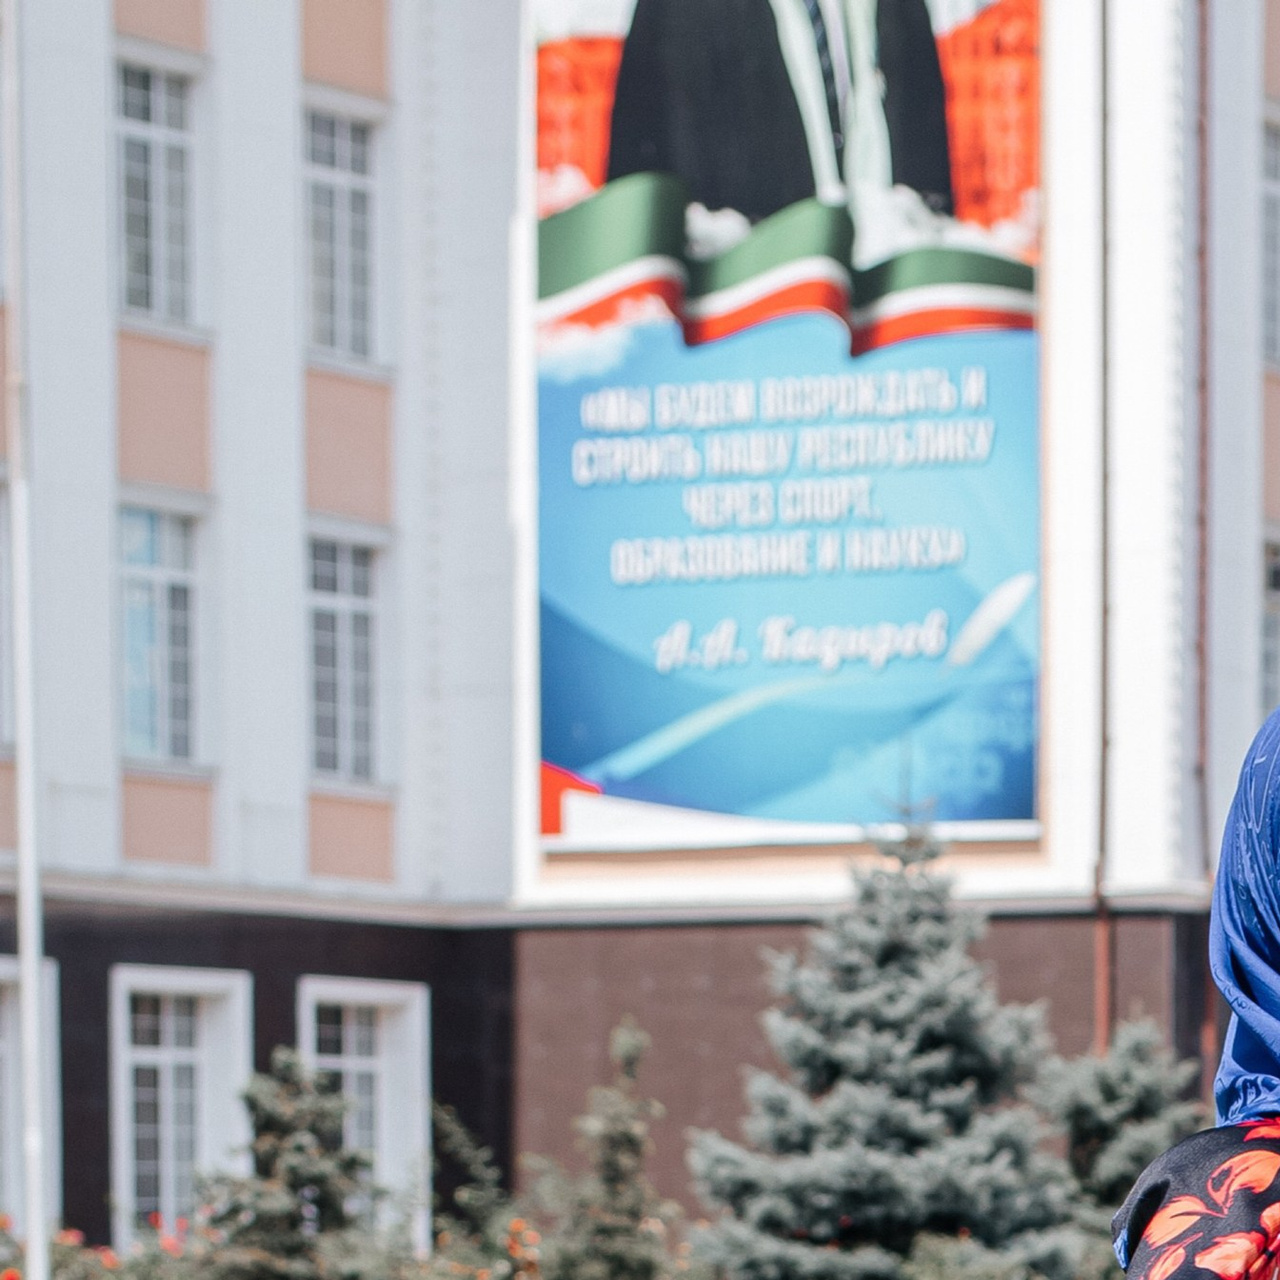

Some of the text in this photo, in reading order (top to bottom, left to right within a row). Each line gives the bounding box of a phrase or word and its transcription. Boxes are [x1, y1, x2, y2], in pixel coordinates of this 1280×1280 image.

[657, 383, 753, 426] БУДЕМ
[963, 368, 985, 406] И
[574, 420, 992, 483] СТРОИТЬ НАШУ РЕСПУБЛИКУ
[685, 483, 772, 525] ЧЕРЕЗ
[613, 532, 808, 582] ОБРАЗОВАНИЕ
[818, 531, 838, 569] И
